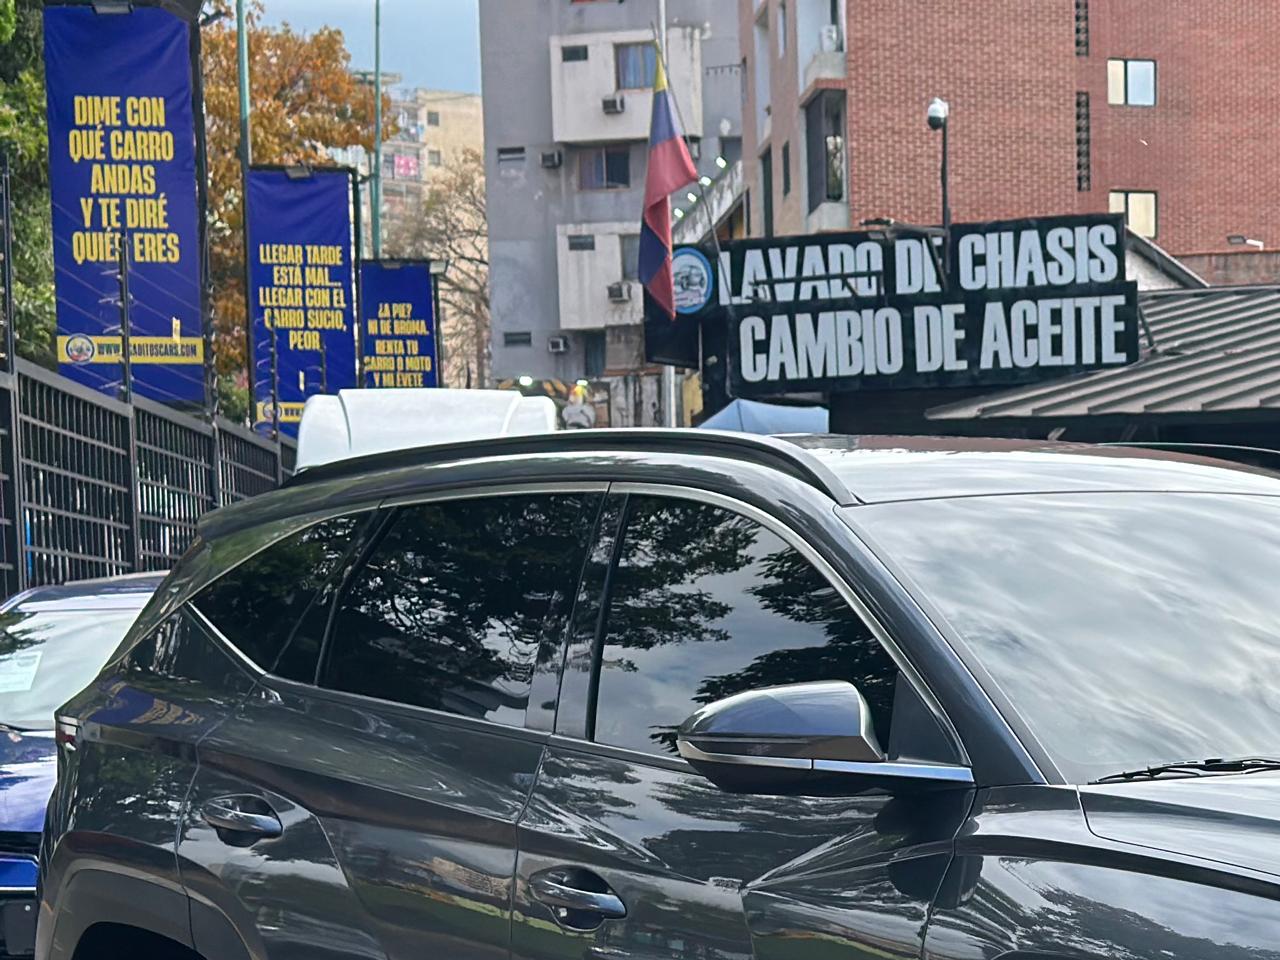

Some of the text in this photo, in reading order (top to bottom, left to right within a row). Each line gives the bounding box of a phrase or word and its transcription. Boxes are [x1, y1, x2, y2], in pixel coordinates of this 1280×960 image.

[74, 96, 165, 127] DIME CON
[69, 124, 174, 163] QUÉ CARRO
[91, 163, 156, 195] ANDAS
[80, 192, 168, 228] Y TE DIRÉ
[133, 232, 180, 263] ERES
[259, 244, 343, 266] LLEGAR TARDE
[719, 241, 883, 306] LAVADO
[958, 224, 1119, 292] CHASIS
[259, 286, 346, 308] LLEGAR CON EL
[264, 308, 347, 332] CARRO SUCIO,
[739, 294, 1128, 383] CAMBIO DE ACEITE
